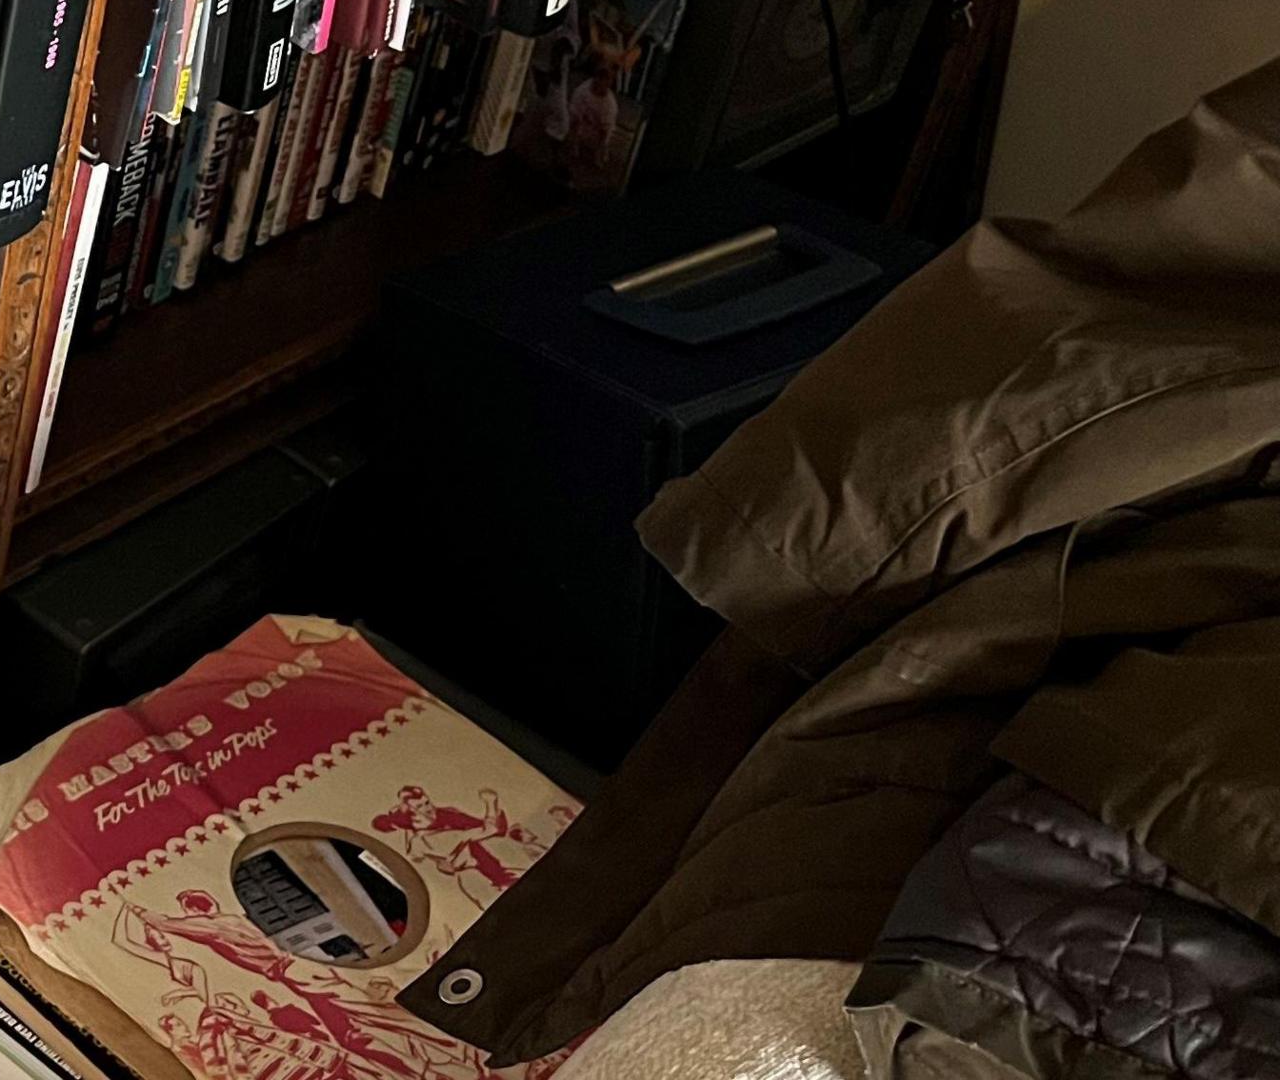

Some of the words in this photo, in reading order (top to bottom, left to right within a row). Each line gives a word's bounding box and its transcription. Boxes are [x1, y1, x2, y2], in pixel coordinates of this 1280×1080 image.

[58, 714, 213, 802] MASTER'S
[224, 648, 323, 710] VOICE
[93, 800, 136, 833] For
[124, 776, 170, 811] The
[161, 760, 207, 786] Tops
[207, 747, 232, 770] in
[223, 718, 277, 755] Pops
